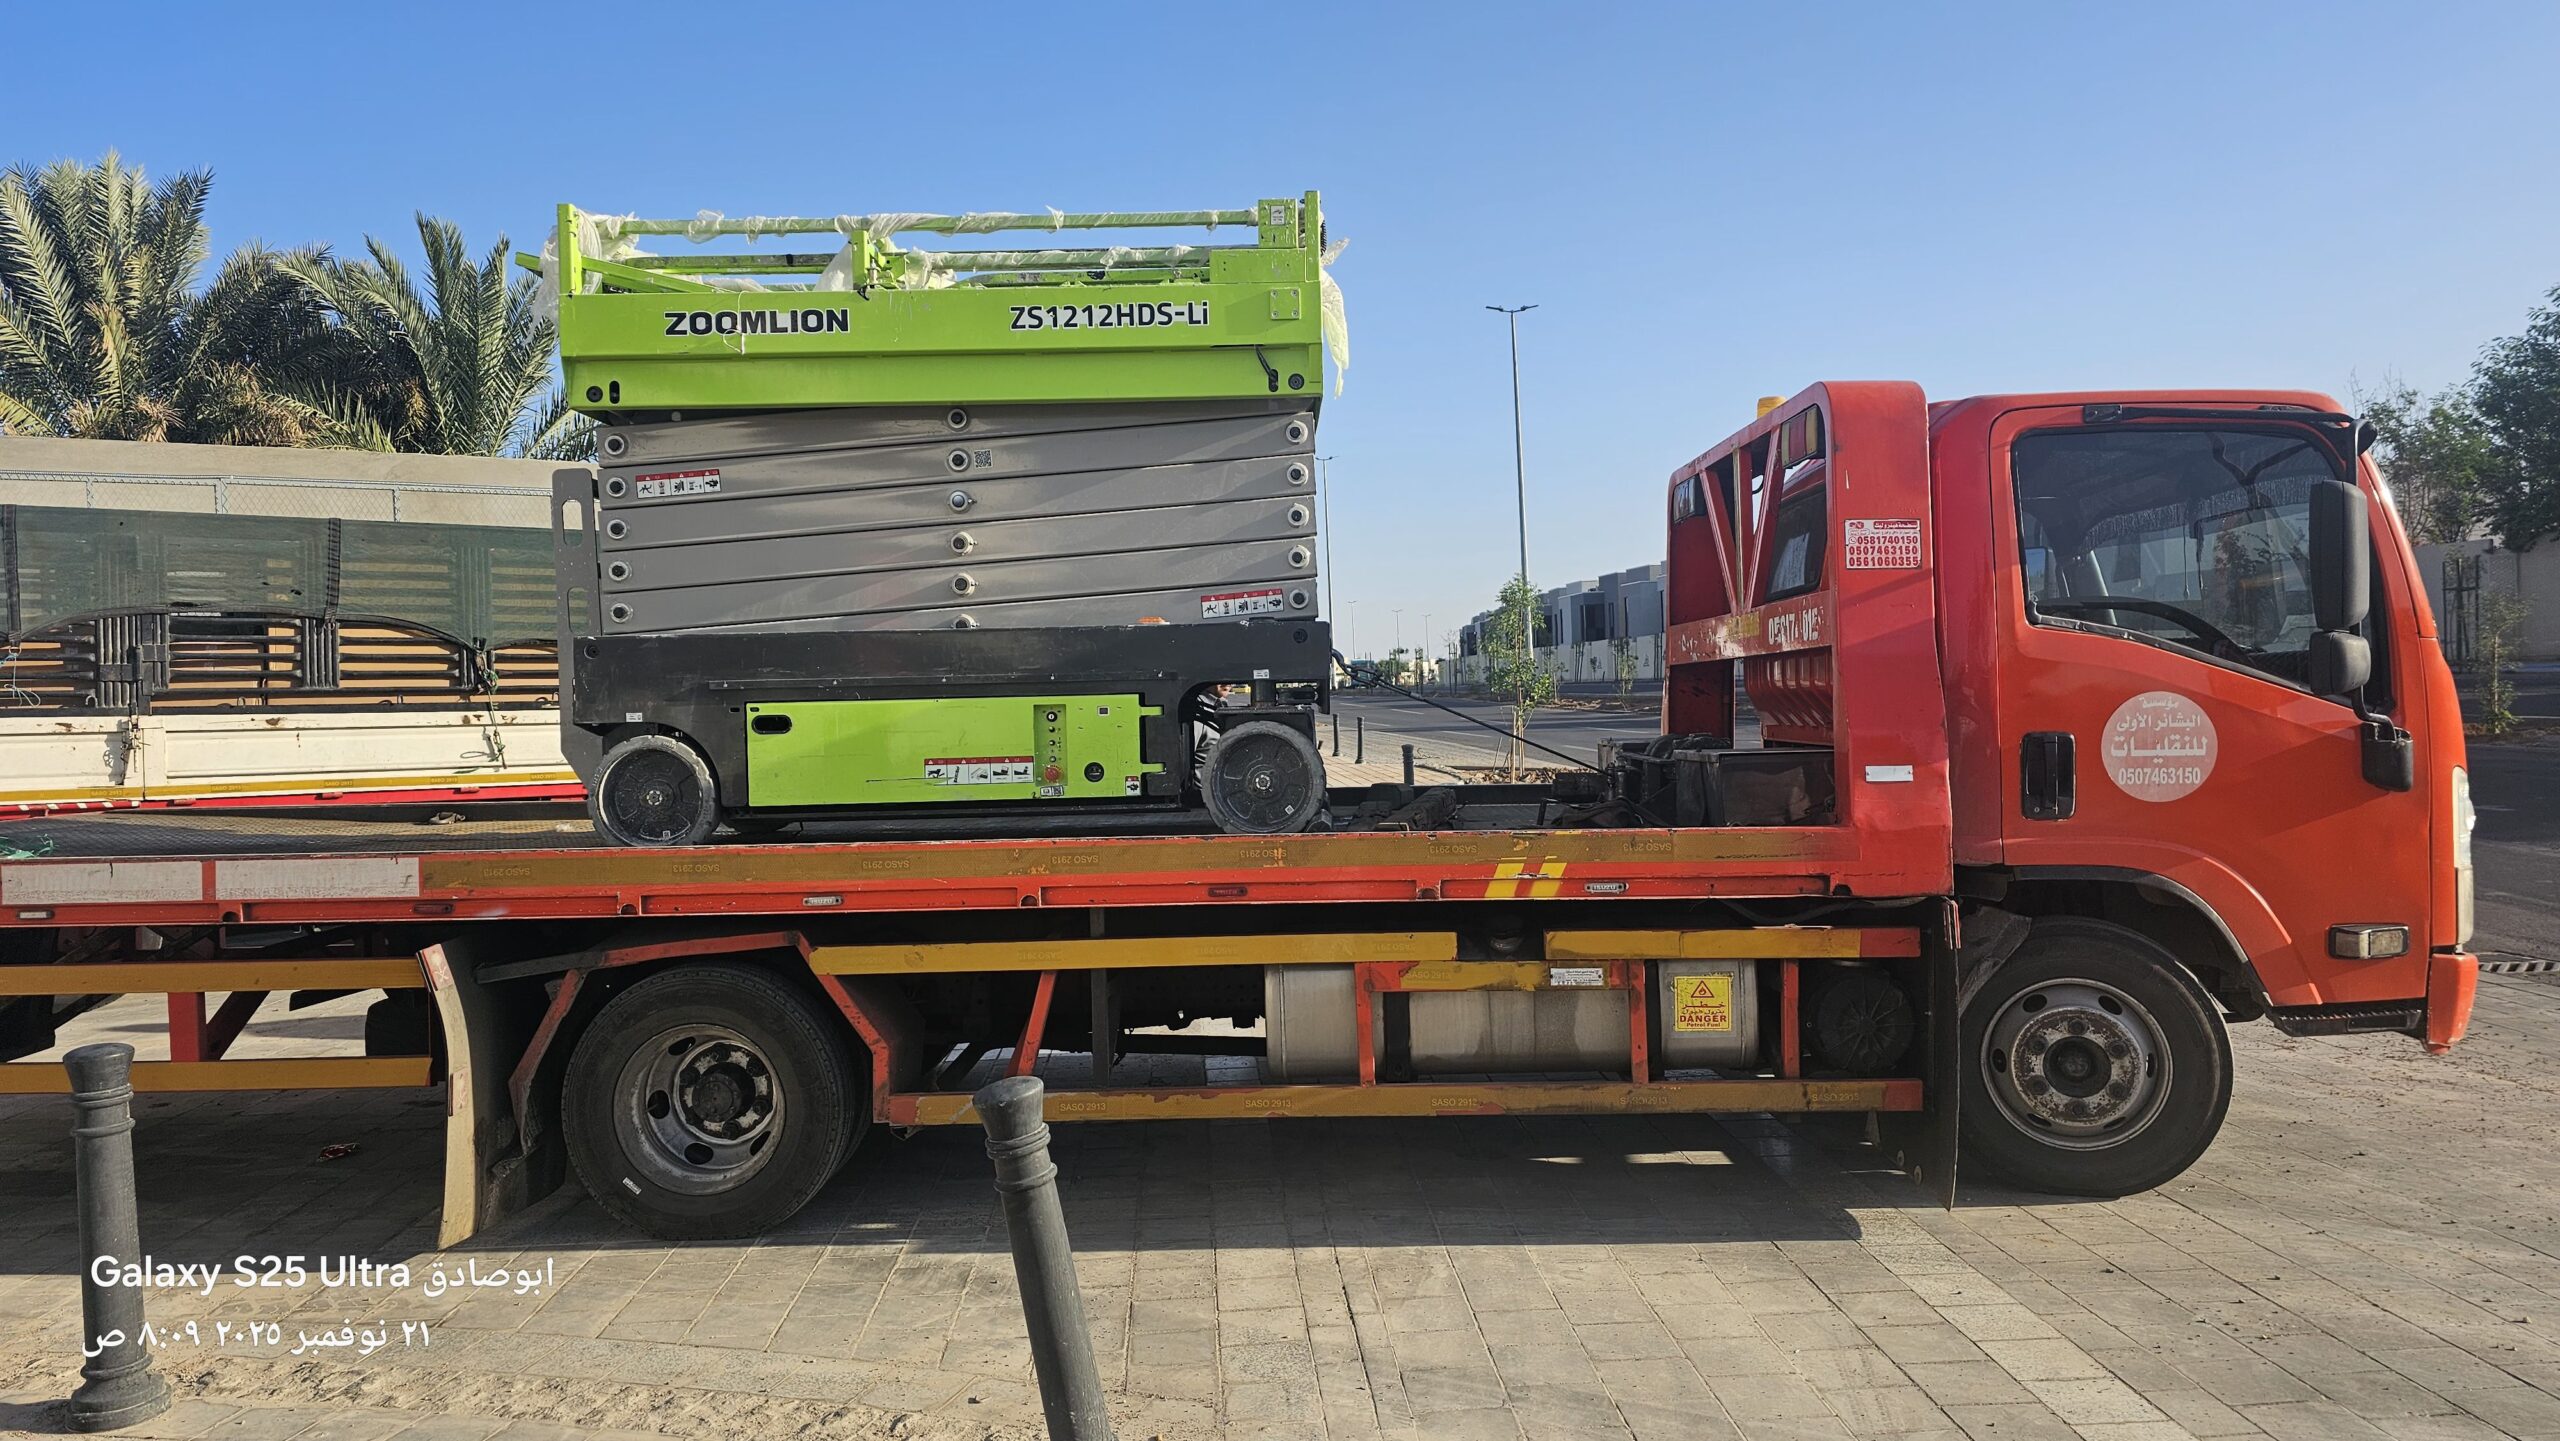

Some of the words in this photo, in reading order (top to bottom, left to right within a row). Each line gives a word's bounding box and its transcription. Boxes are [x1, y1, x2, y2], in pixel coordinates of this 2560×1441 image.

[1010, 301, 1208, 330] ZS1212HDS-Li
[664, 308, 849, 336] ZOOMLION
[1857, 536, 1918, 544] 0581740150
[1849, 546, 1918, 555] 0507463150
[1849, 557, 1919, 566] 0561060355
[2139, 696, 2179, 710] مؤسسة
[2111, 734, 2208, 763] للنقليات
[2119, 767, 2201, 785] 0507463150
[1051, 856, 1072, 864] 2913
[1074, 855, 1099, 863] SASO
[695, 864, 720, 872] SASO
[885, 860, 910, 868] SASO
[1682, 1001, 1726, 1009] خطر
[1060, 1103, 1084, 1111] SASO
[1086, 1102, 1106, 1111] 2913
[1245, 1100, 1270, 1108] SASO
[1271, 1099, 1291, 1107] 2913
[1431, 1098, 1456, 1106] SASO
